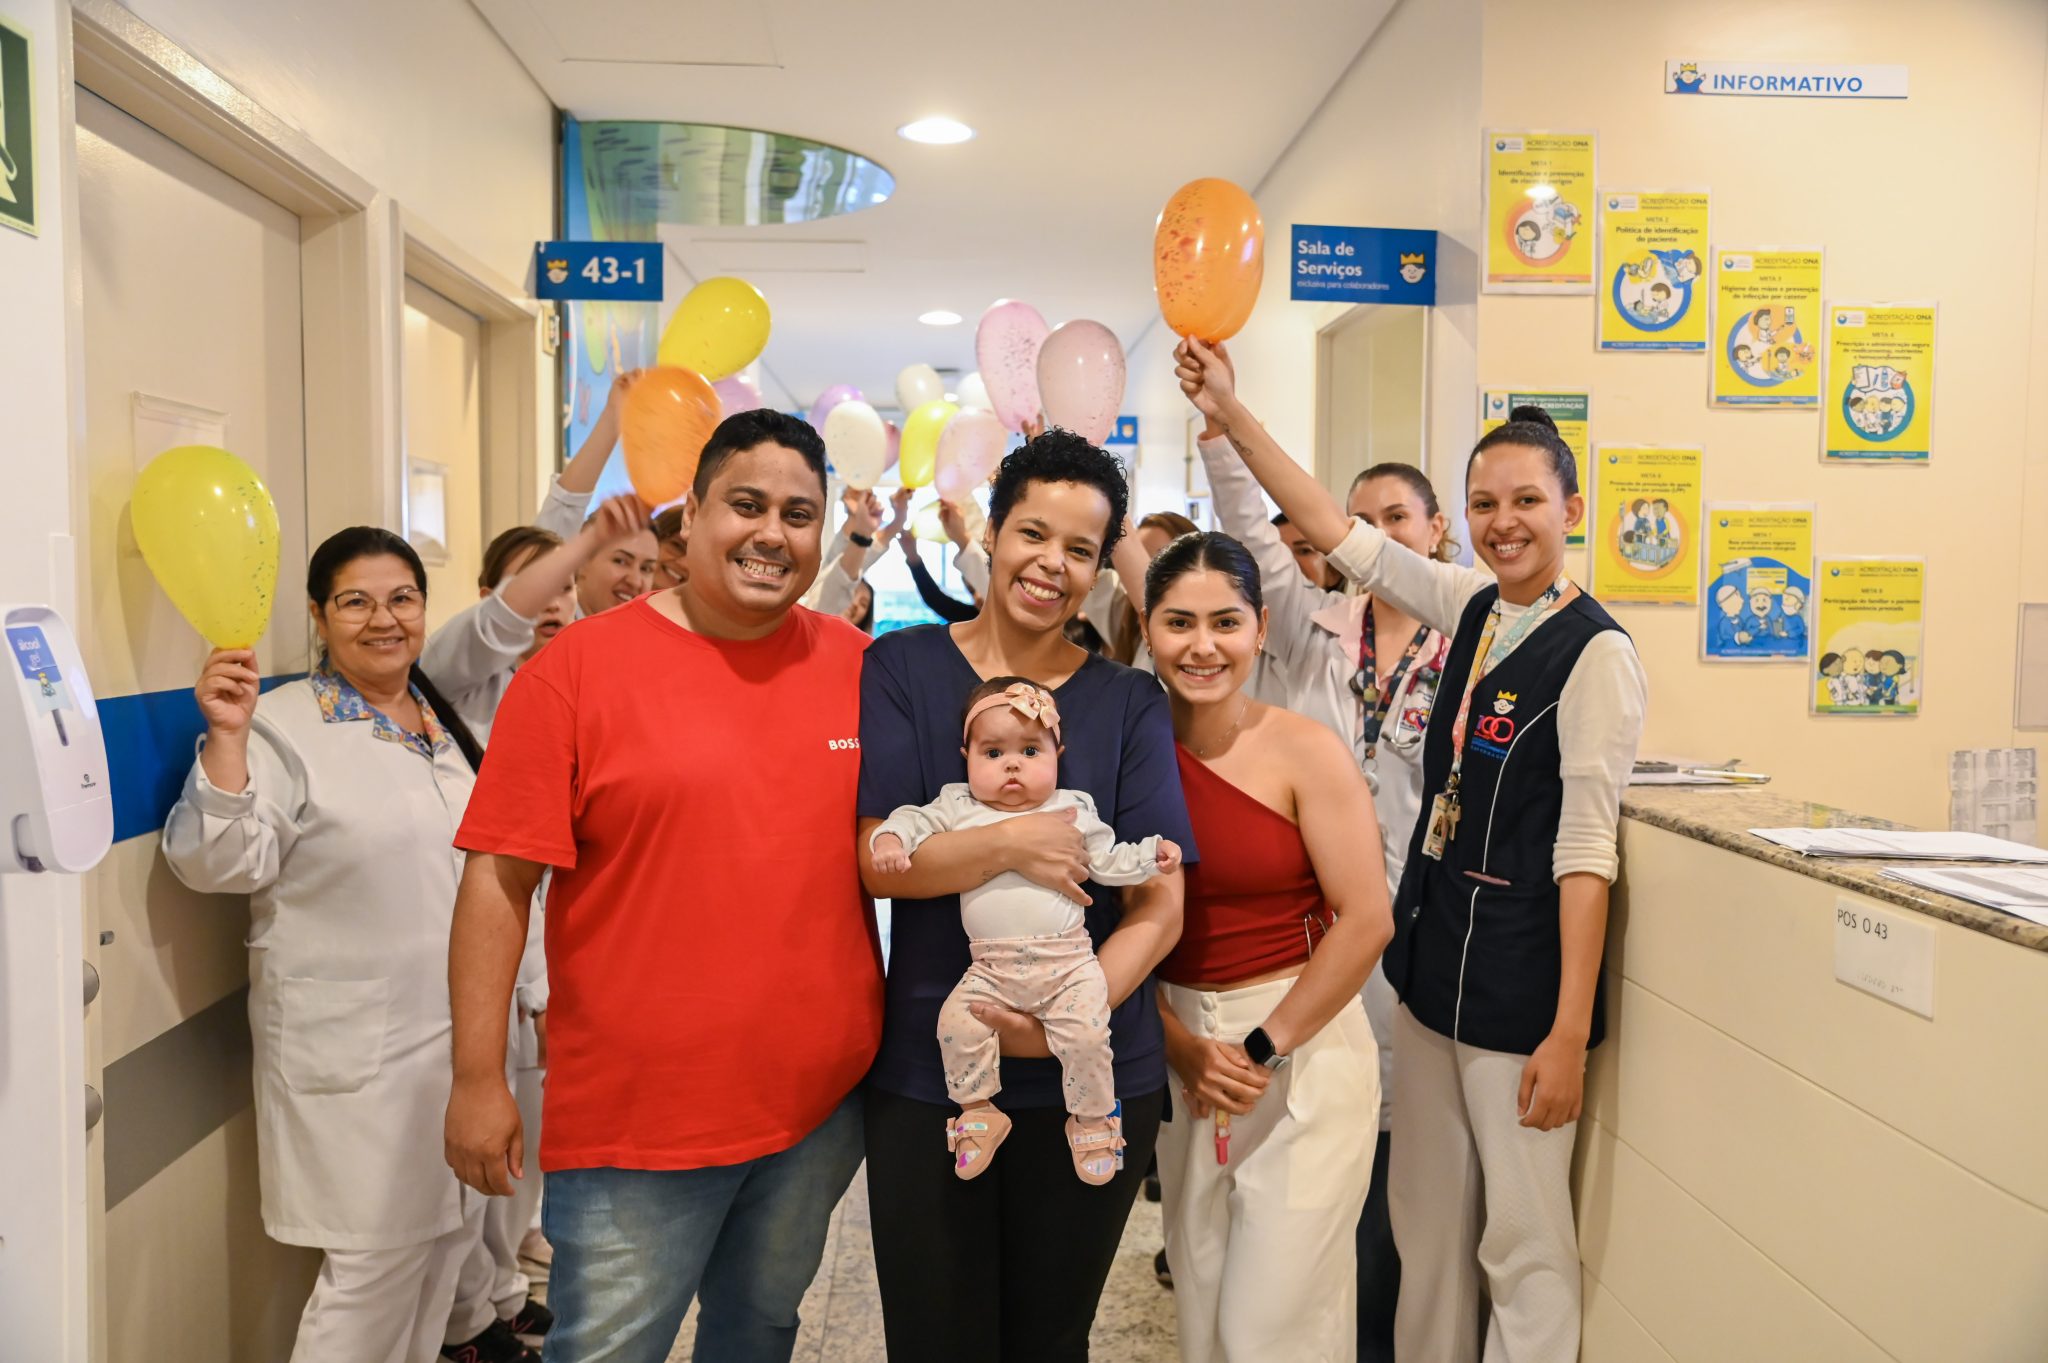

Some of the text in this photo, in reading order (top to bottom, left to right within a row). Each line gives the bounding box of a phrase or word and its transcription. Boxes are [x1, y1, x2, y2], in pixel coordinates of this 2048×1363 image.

[1713, 74, 1863, 93] INFORMATIVO
[1641, 197, 1689, 206] ACREDITAÇÃO
[1616, 226, 1641, 234] Política
[1654, 226, 1698, 236] identificação
[1647, 236, 1677, 244] paciente
[1297, 240, 1355, 257] Sala de
[1755, 257, 1801, 265] ACREDITAÇÃO
[581, 256, 645, 284] 43-1
[1297, 260, 1363, 280] Serviços
[1327, 282, 1342, 290] para
[1343, 281, 1390, 291] colaboradores
[1721, 285, 1746, 293] Higiene
[1785, 286, 1818, 294] prevenção
[1867, 313, 1914, 321] ACREDITAÇÃO
[828, 738, 860, 751] BOSS
[1837, 908, 1857, 929] POS
[1874, 921, 1888, 940] 43
